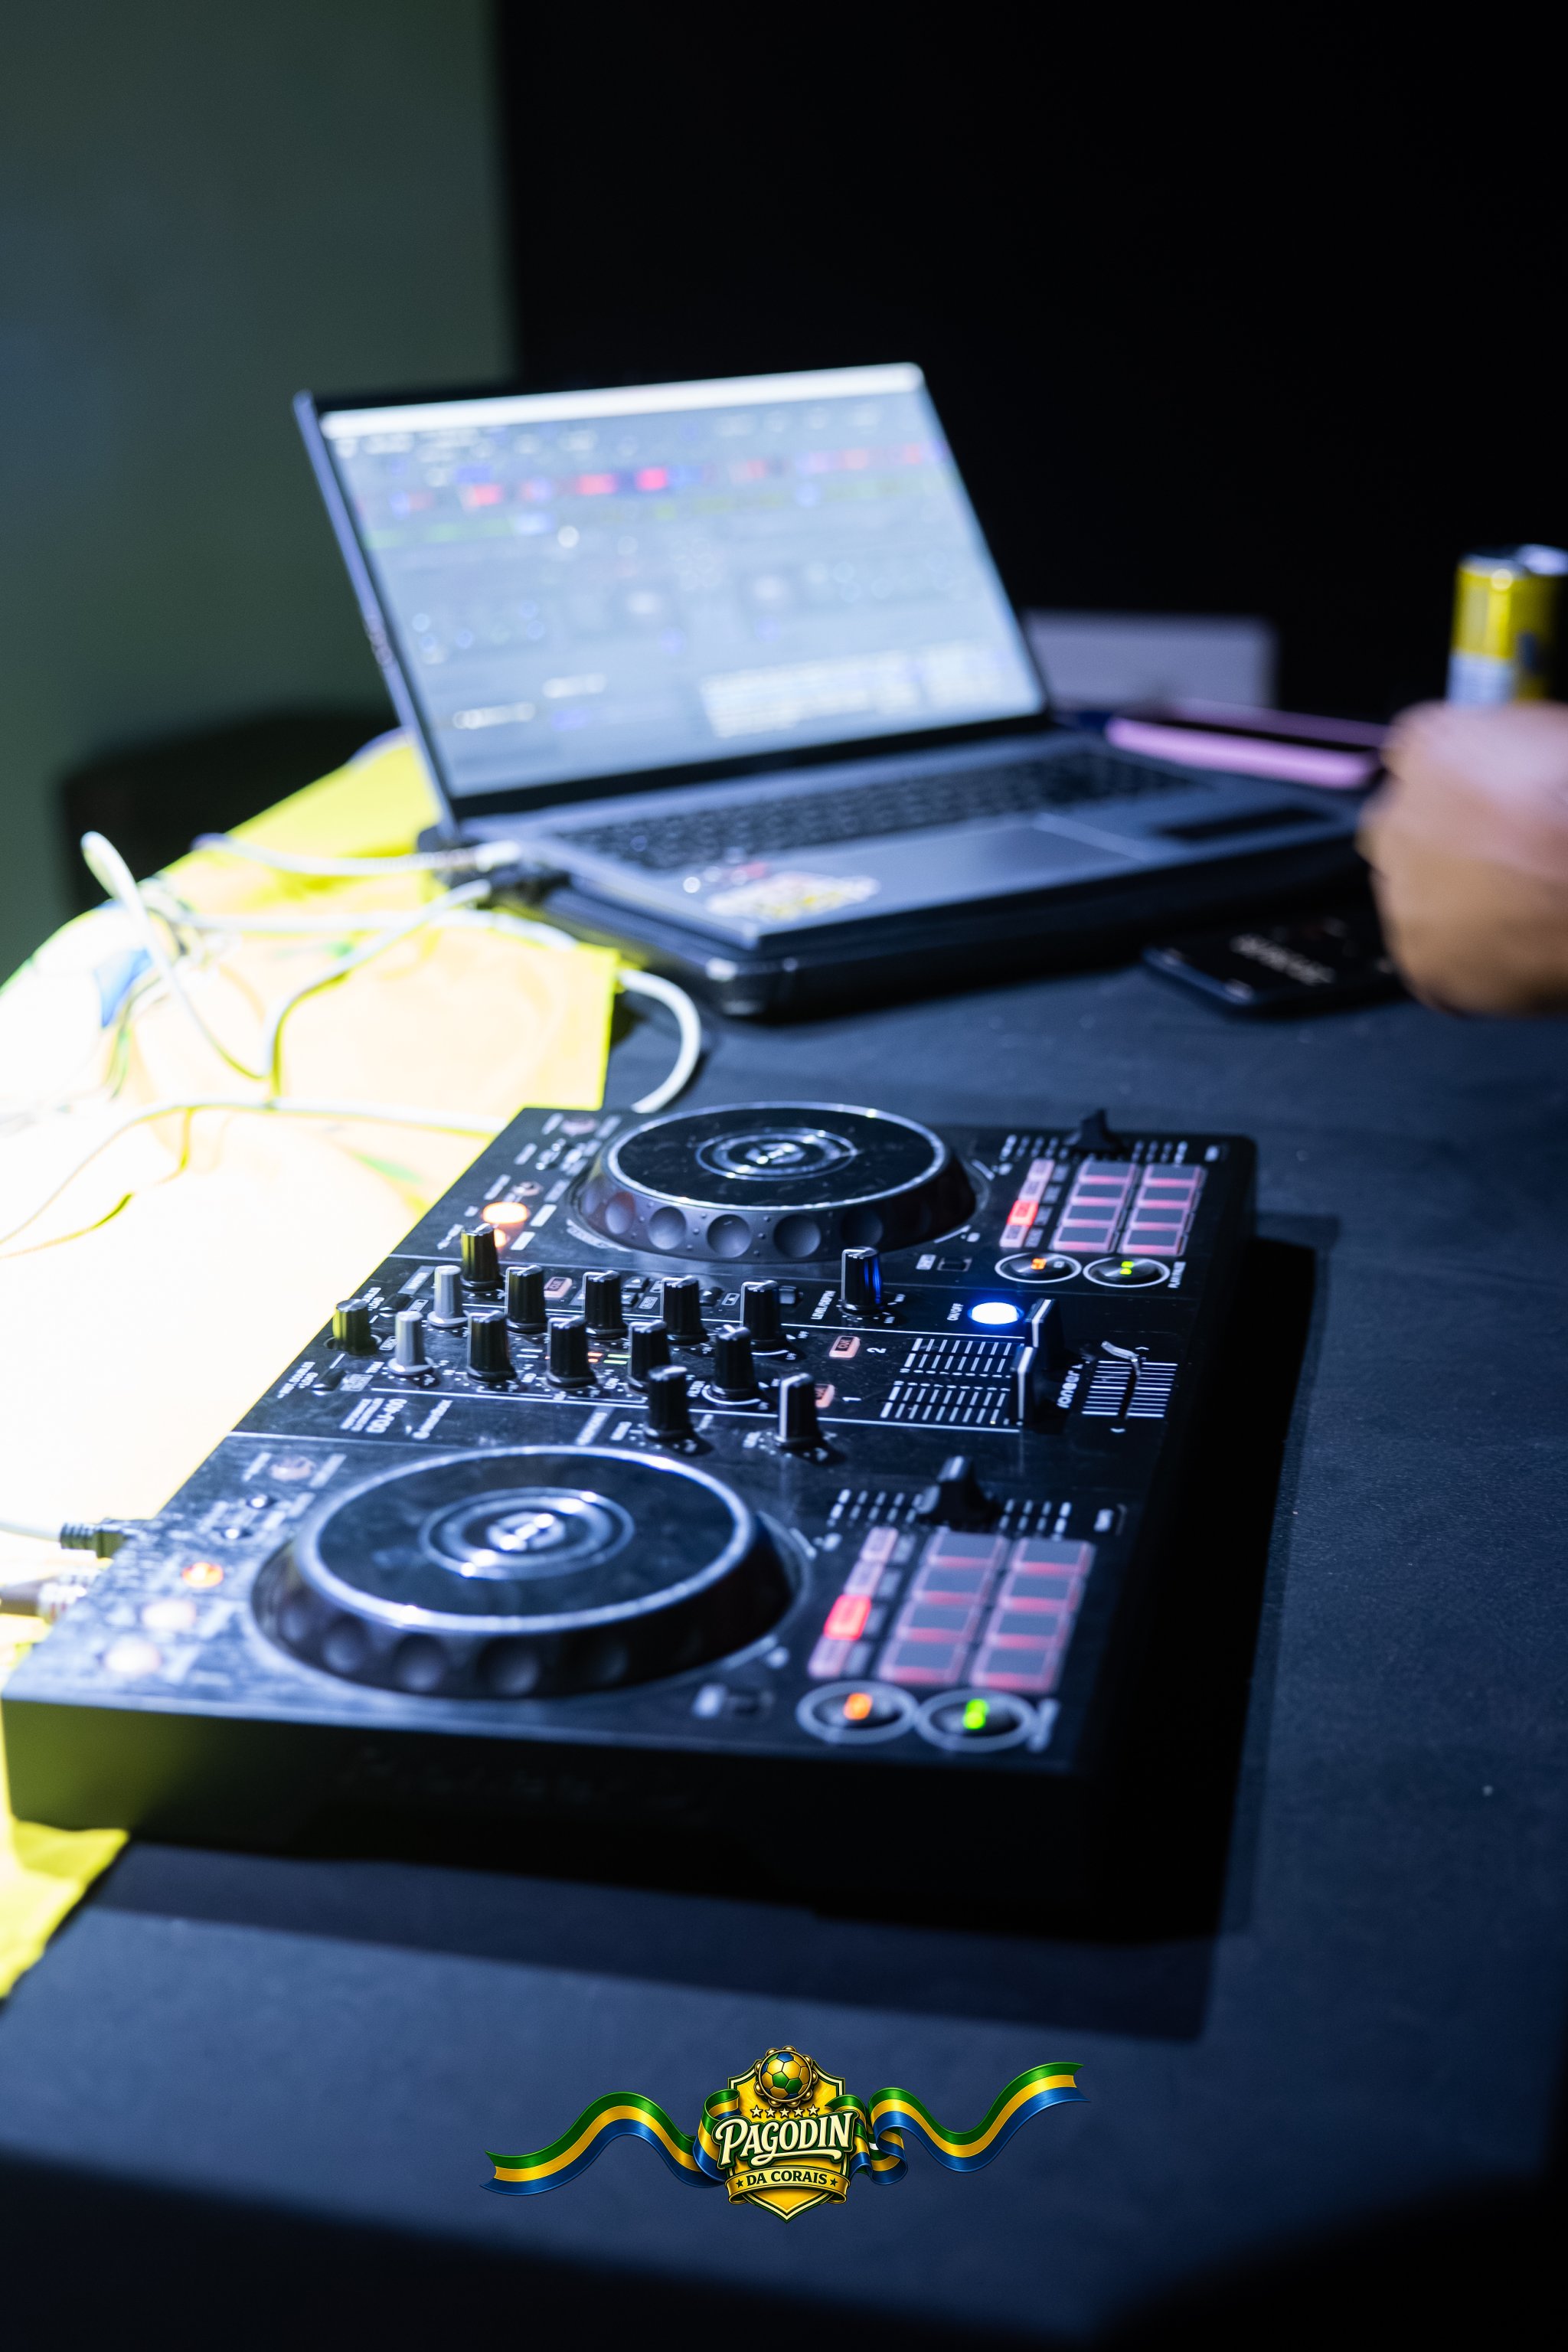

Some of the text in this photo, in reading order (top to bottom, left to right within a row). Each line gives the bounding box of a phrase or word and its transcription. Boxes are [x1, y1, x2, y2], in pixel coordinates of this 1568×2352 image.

[810, 1290, 837, 1320] LEVEL/DEPTH
[946, 1303, 964, 1321] ON/OFF
[687, 1380, 706, 1397] FILTER
[1057, 1370, 1080, 1409] ioneer
[365, 1398, 408, 1433] DDJ-400
